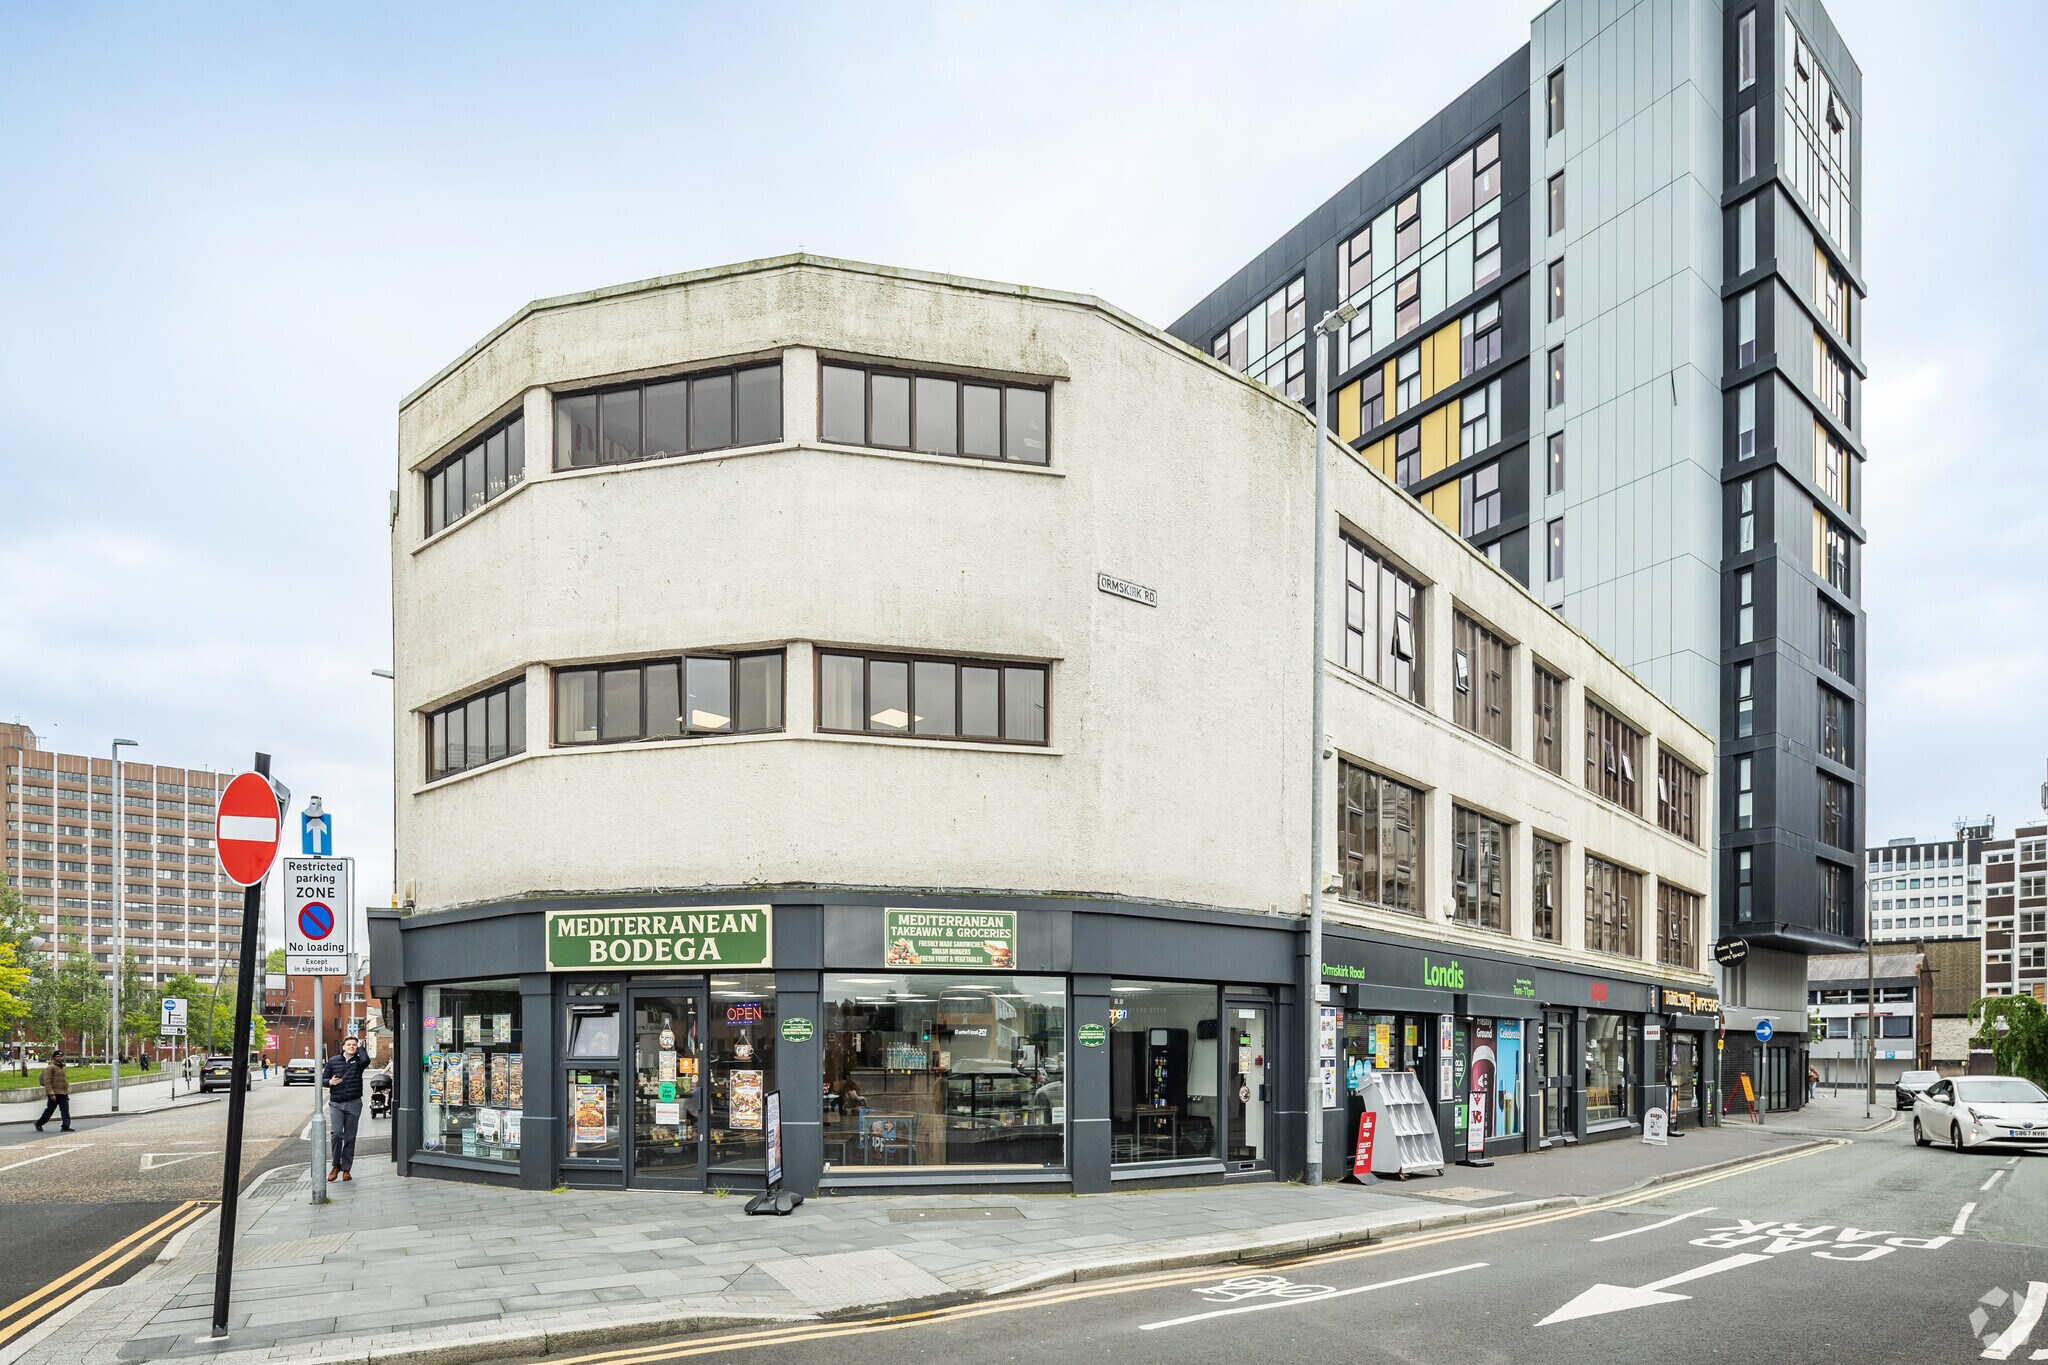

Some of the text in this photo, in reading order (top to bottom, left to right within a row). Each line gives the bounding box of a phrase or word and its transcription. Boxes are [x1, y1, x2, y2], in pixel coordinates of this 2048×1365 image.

[1101, 577, 1141, 599] ORMSKIRK
[289, 862, 343, 871] Restricted
[296, 874, 335, 884] parking
[296, 887, 335, 898] ZONE
[557, 913, 758, 937] MEDITERRANEAN
[898, 914, 1004, 928] MEDITERRANEAN
[890, 926, 1012, 938] TAKEAWAY & GROCERIES
[289, 942, 345, 953] No loading
[588, 937, 722, 963] BODEGA
[1322, 963, 1365, 979] Ormskirk Road
[1424, 957, 1464, 989] Londis
[726, 1007, 762, 1021] OPEN
[1477, 1028, 1493, 1038] Ground
[1704, 1219, 1956, 1250] PARK
[1688, 1232, 1897, 1261] CAR
